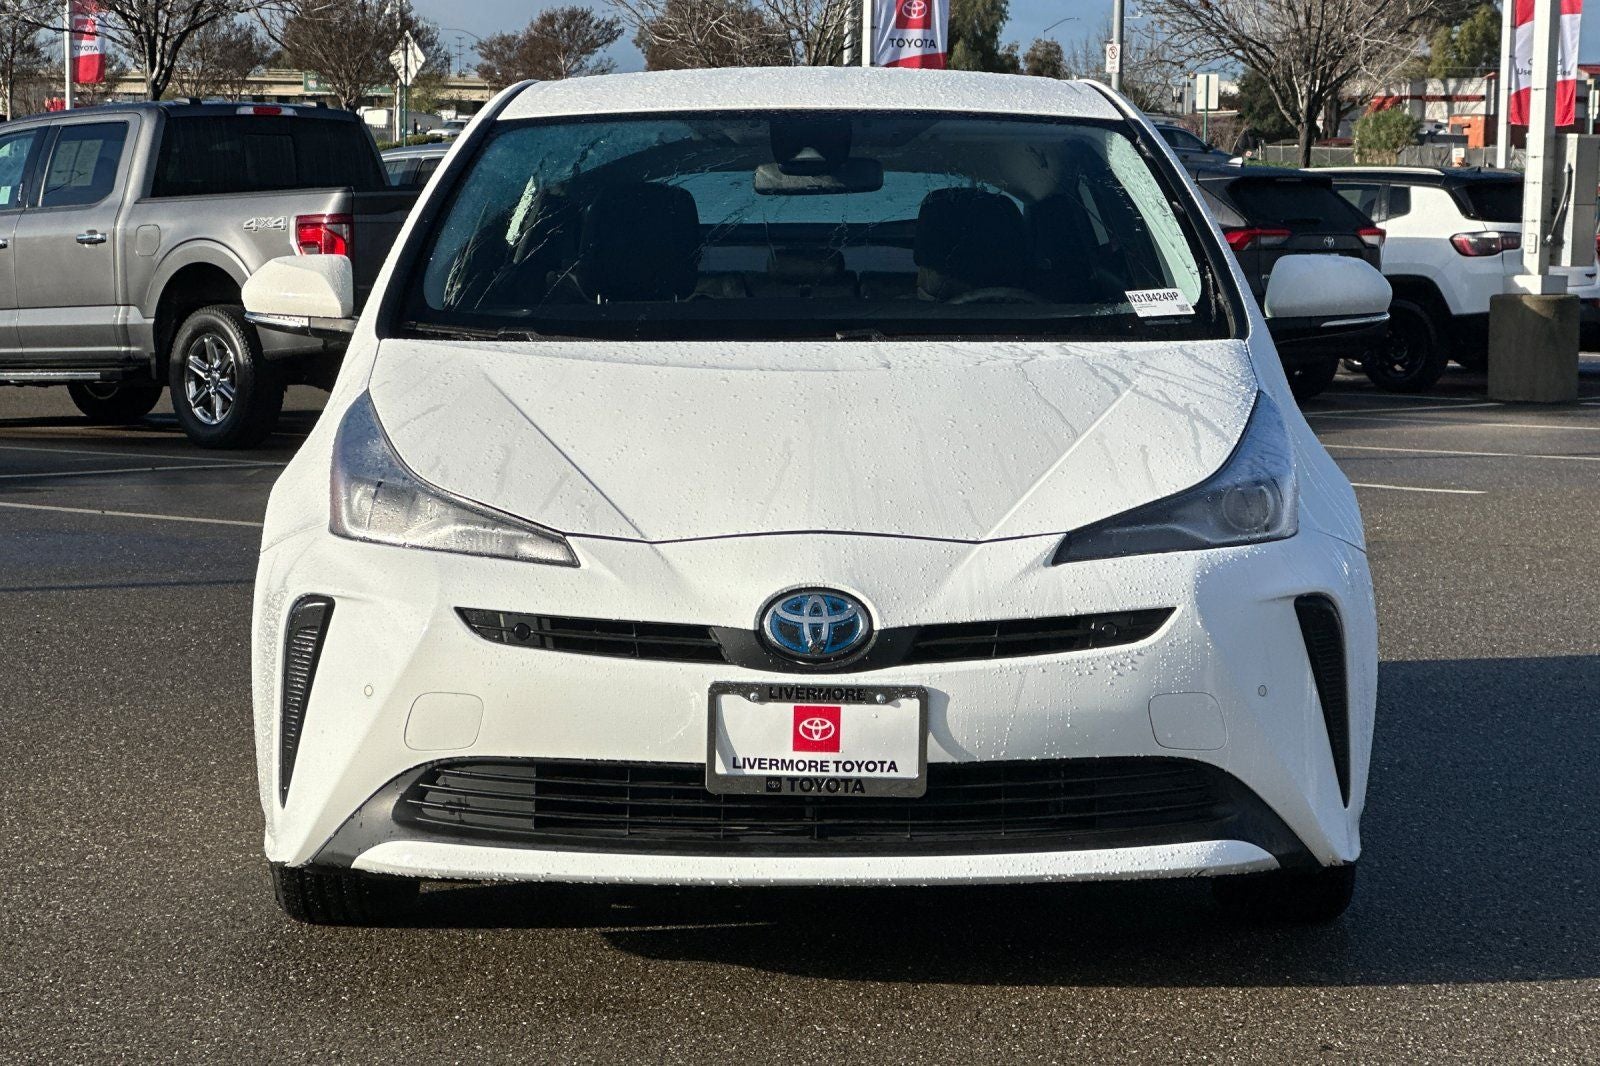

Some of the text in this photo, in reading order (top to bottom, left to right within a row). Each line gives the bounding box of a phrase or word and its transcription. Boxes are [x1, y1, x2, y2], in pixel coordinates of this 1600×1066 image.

[889, 38, 937, 49] TOYOTA
[1128, 291, 1179, 303] N3184249P
[768, 686, 867, 702] LIVERMORE
[732, 757, 899, 773] LIVERMORE TOYOTA
[787, 777, 866, 794] TOYOTA
